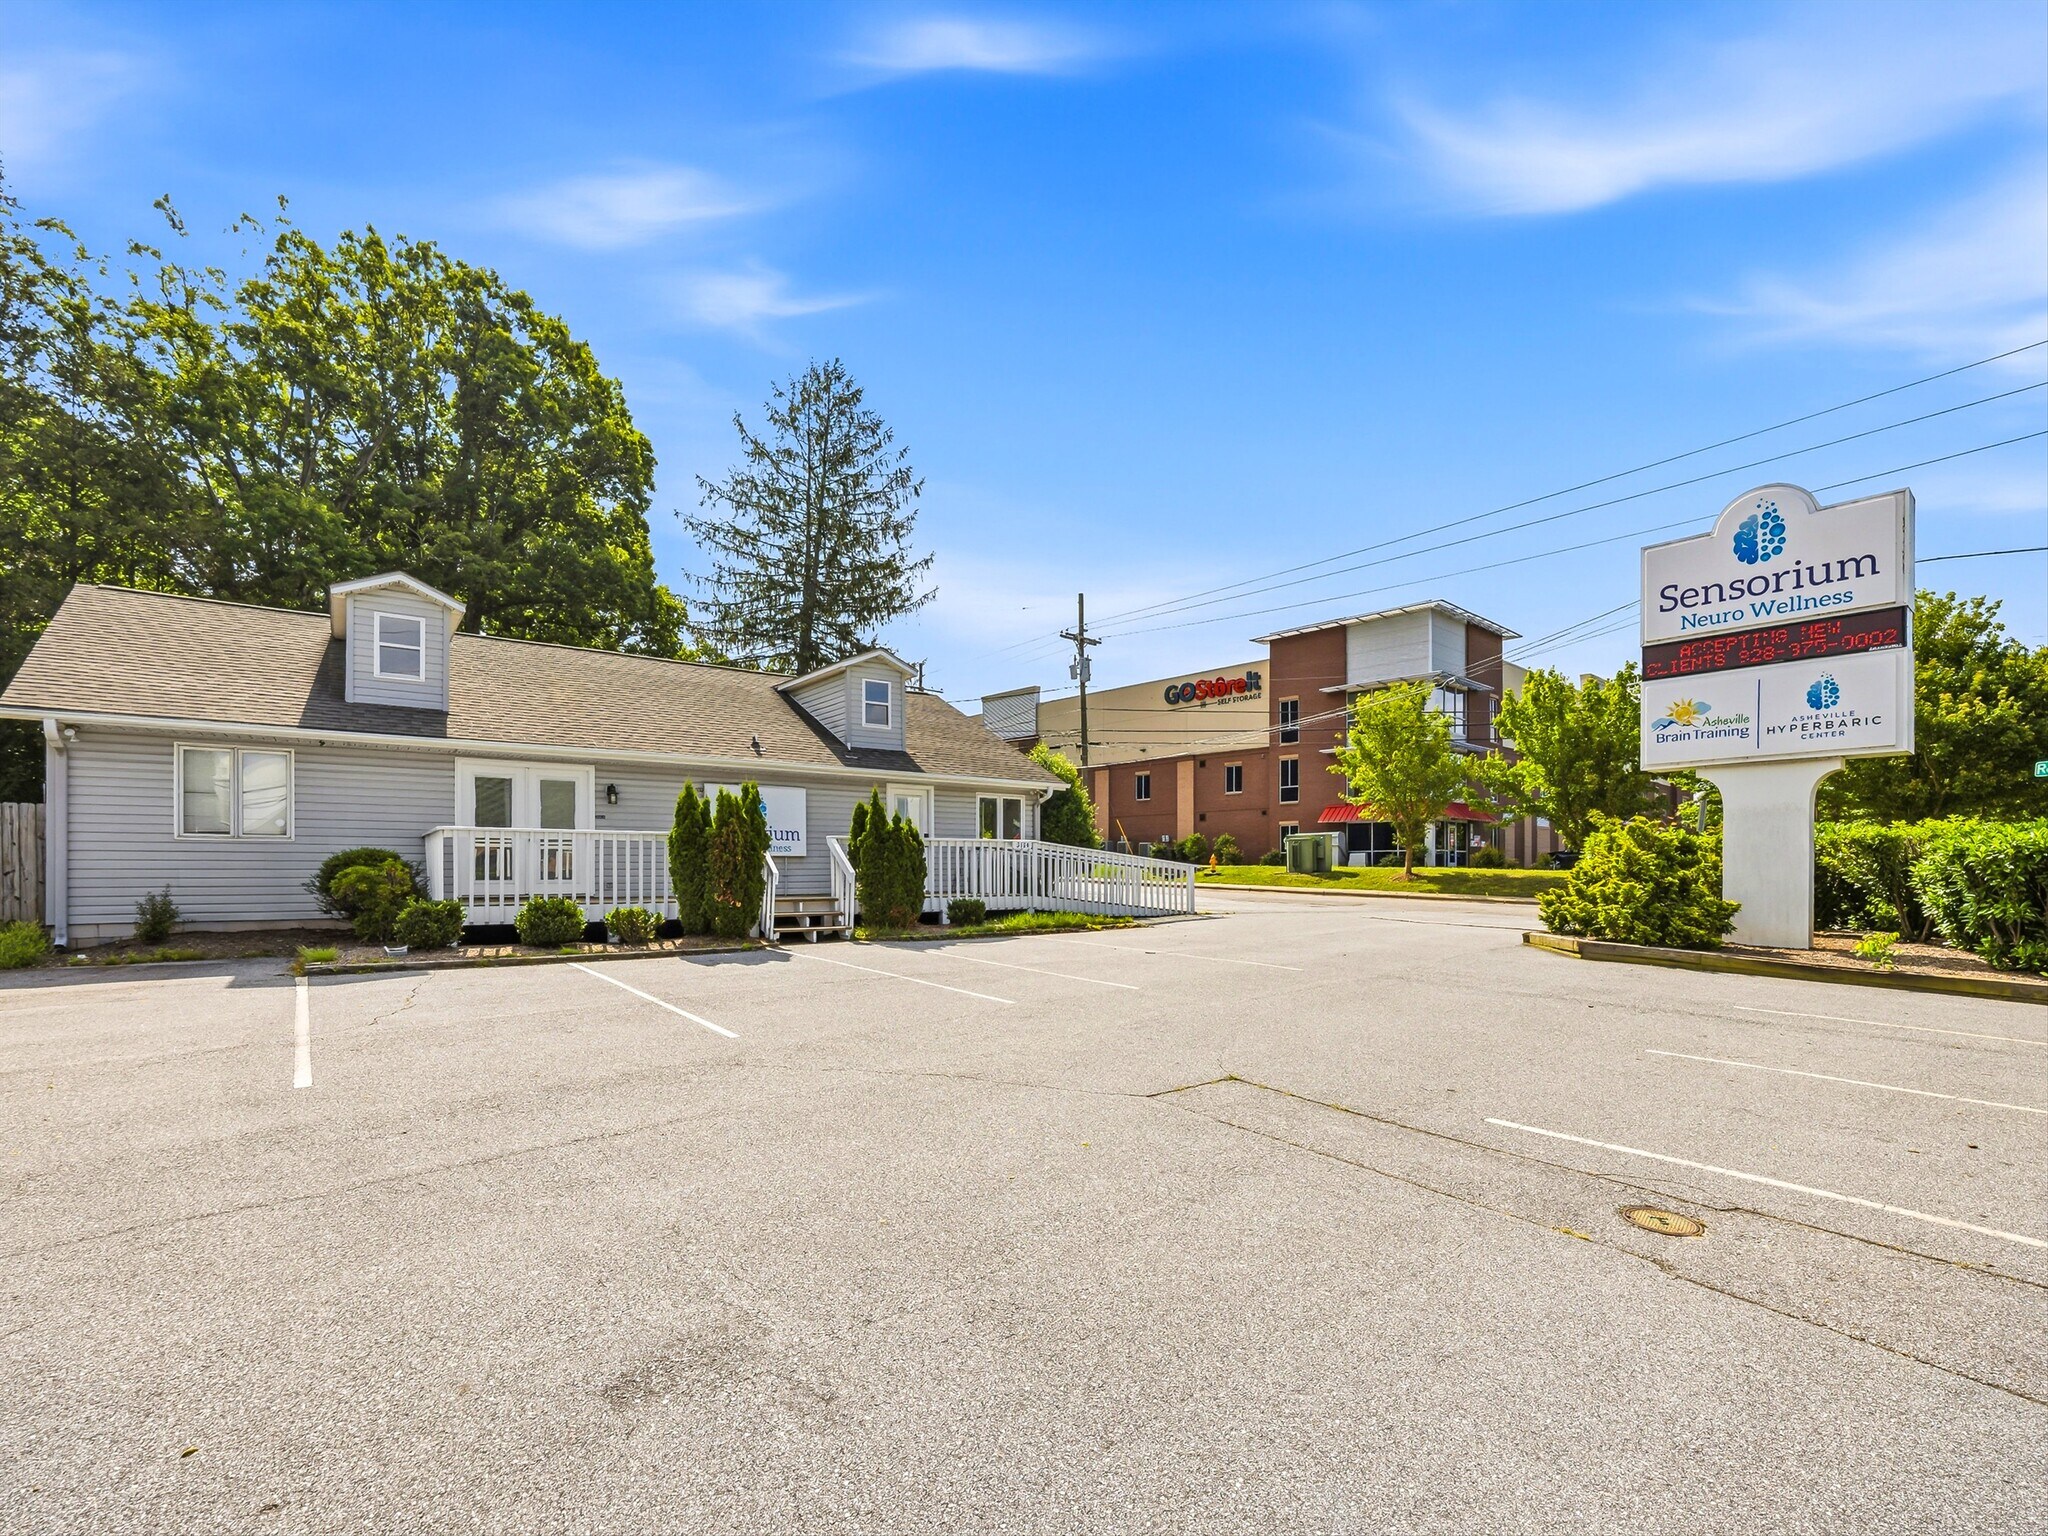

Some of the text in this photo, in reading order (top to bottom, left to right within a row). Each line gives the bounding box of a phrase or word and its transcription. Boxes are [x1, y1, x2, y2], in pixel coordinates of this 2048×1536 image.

[1659, 553, 1880, 613] Sensorium
[1680, 590, 1854, 631] Neuro Wellness
[1680, 621, 1841, 658] ACCEPTING NEW
[1646, 653, 1726, 676] CLIENTS
[1217, 692, 1262, 706] SELF STORAGE
[1702, 713, 1750, 727] Asheville
[1791, 710, 1856, 722] ASHEVILLE
[1766, 716, 1882, 735] HYPERBARIC
[1656, 726, 1750, 744] Brain Training
[1800, 730, 1845, 740] CENTER
